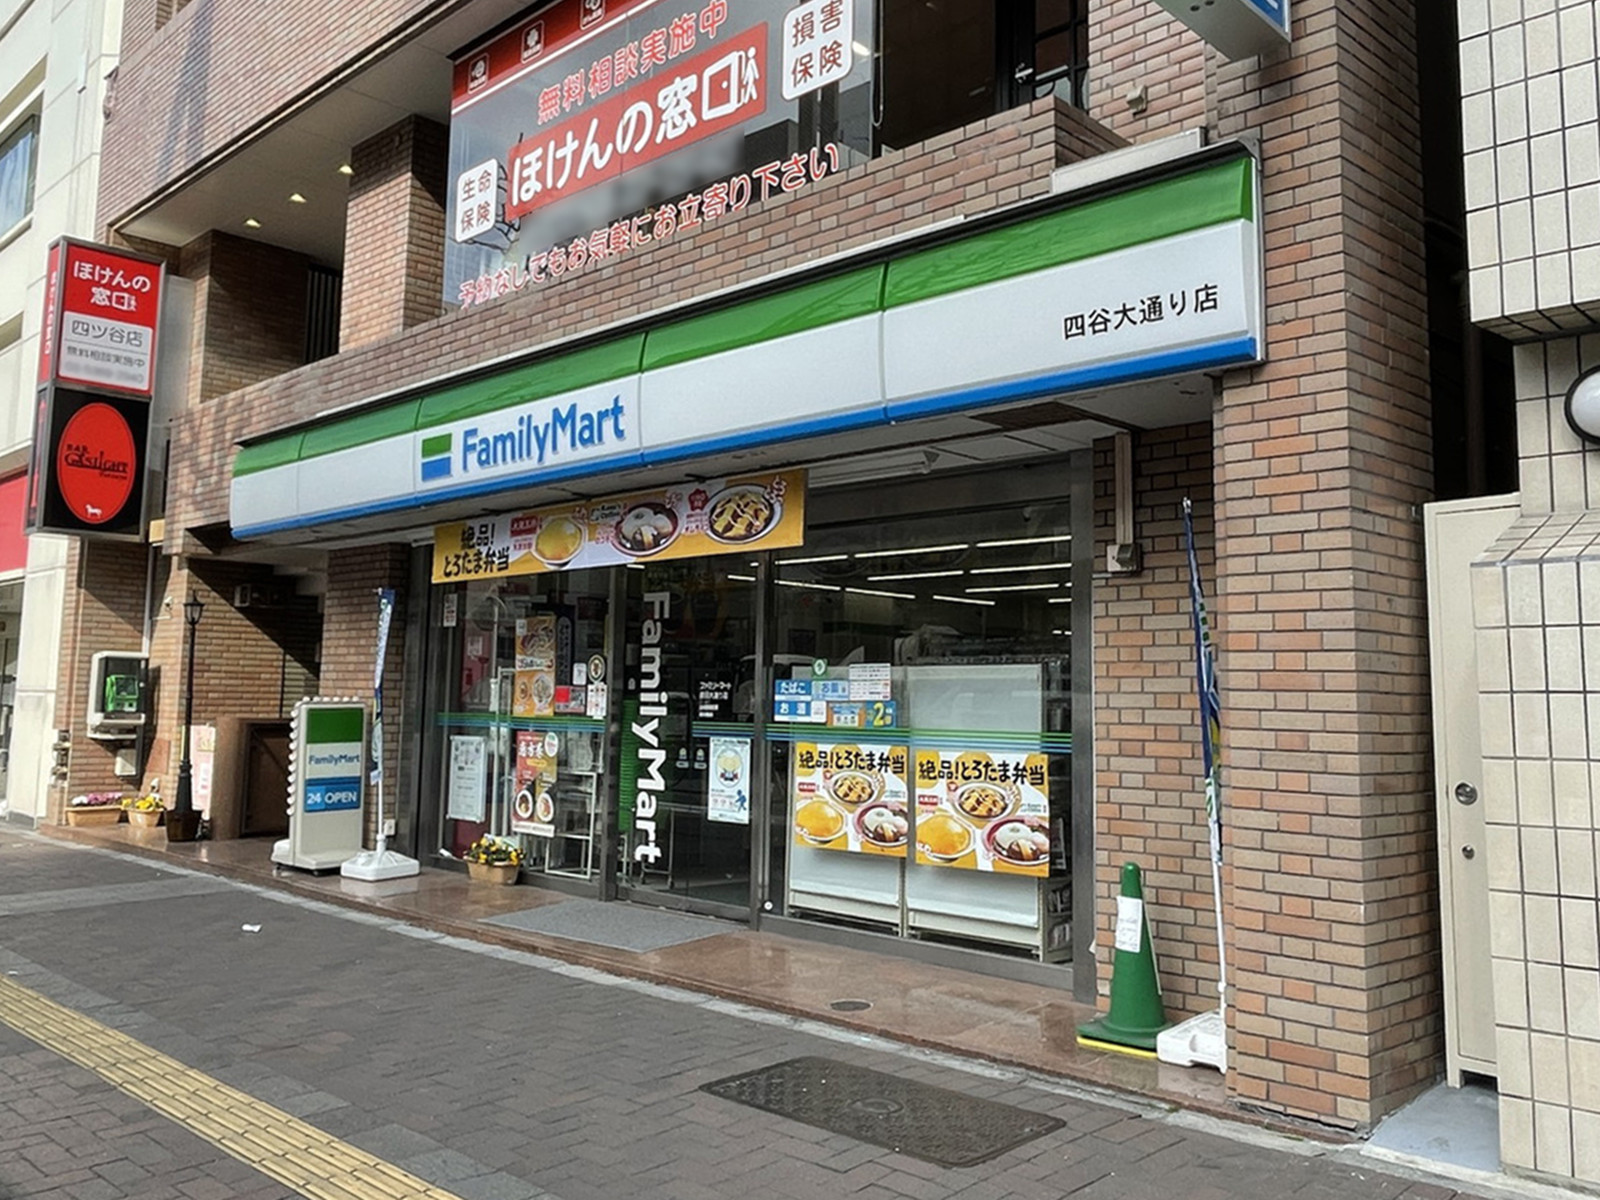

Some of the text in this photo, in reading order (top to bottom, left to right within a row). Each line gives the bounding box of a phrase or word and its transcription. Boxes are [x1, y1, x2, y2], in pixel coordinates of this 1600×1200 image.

[792, 0, 843, 48] 損害
[537, 1, 728, 125] 無料相談実施中
[792, 39, 843, 88] 保険
[511, 50, 742, 206] ほけんの窓口
[461, 169, 493, 201] 生命
[460, 202, 492, 233] 保険
[73, 260, 152, 293] ほけんの
[1063, 283, 1218, 340] 四谷大通り店
[72, 319, 143, 348] 四ツ谷店
[462, 395, 625, 472] FamilyMart
[460, 521, 497, 551] 絶品!
[443, 545, 510, 578] とろたま弁当
[780, 681, 806, 694] たばこ
[632, 591, 671, 864] FamilyMart
[308, 753, 360, 767] FamilyMart
[325, 790, 357, 805] OPEN
